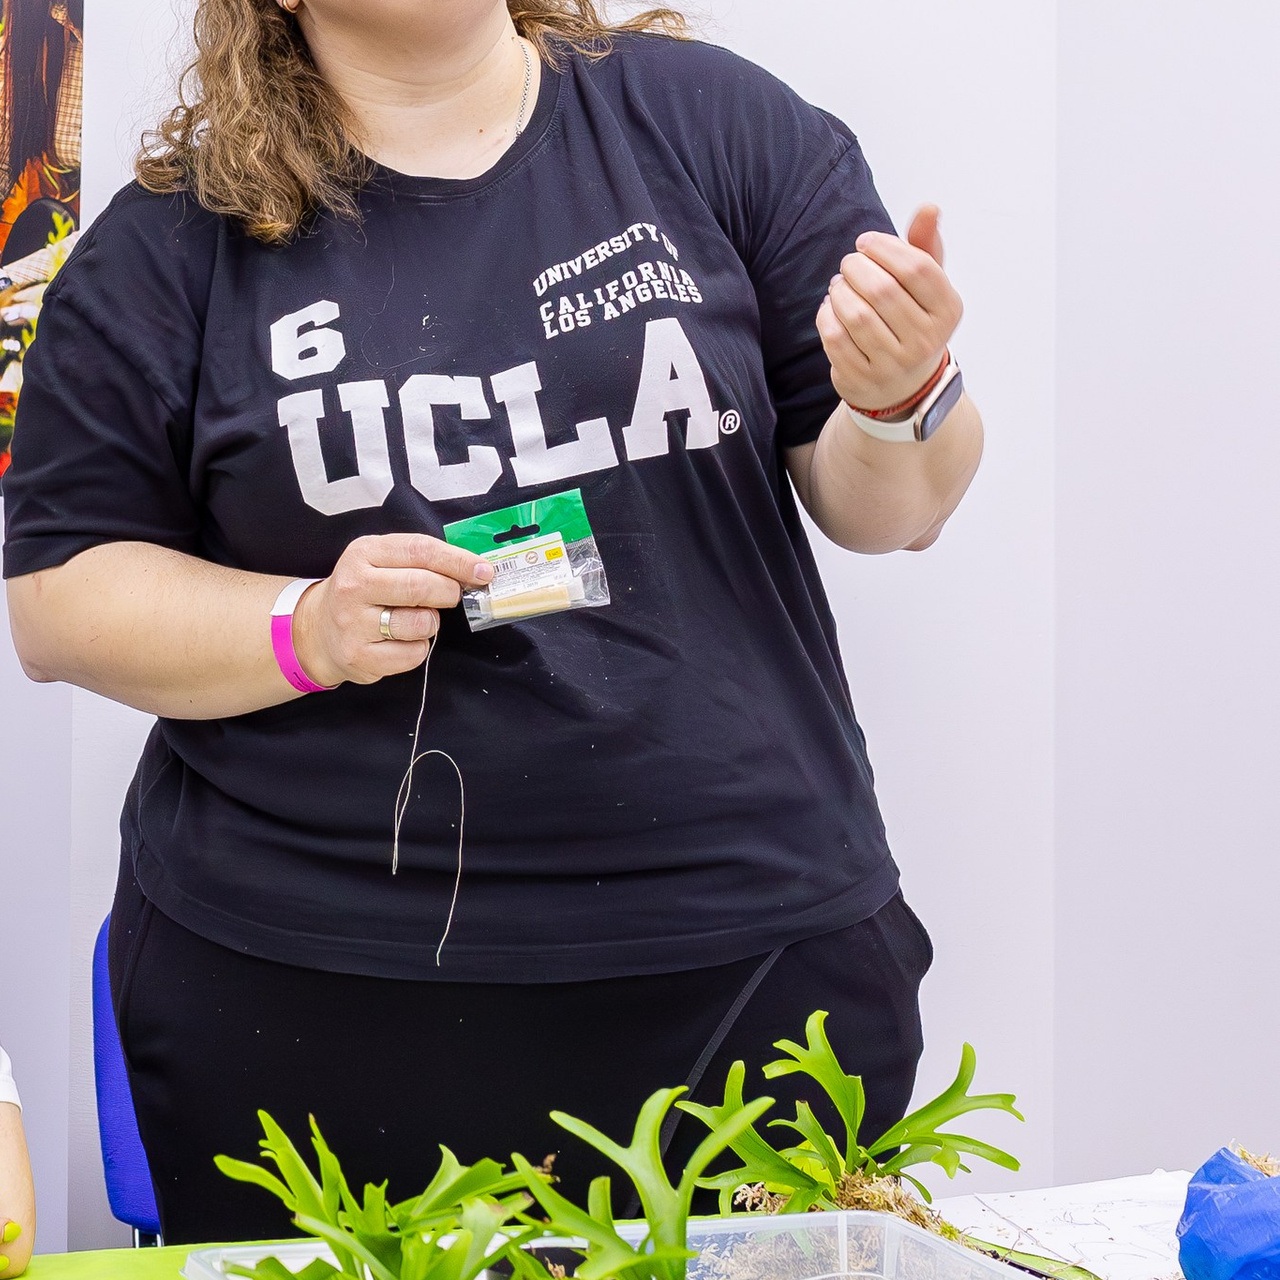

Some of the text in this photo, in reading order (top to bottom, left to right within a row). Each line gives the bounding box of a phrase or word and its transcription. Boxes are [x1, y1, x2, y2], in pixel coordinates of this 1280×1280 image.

[532, 222, 679, 297] UNIVERSITY OF
[539, 260, 695, 322] CALIFORNIA
[269, 299, 347, 381] 6
[543, 279, 704, 340] LOS ANGELES
